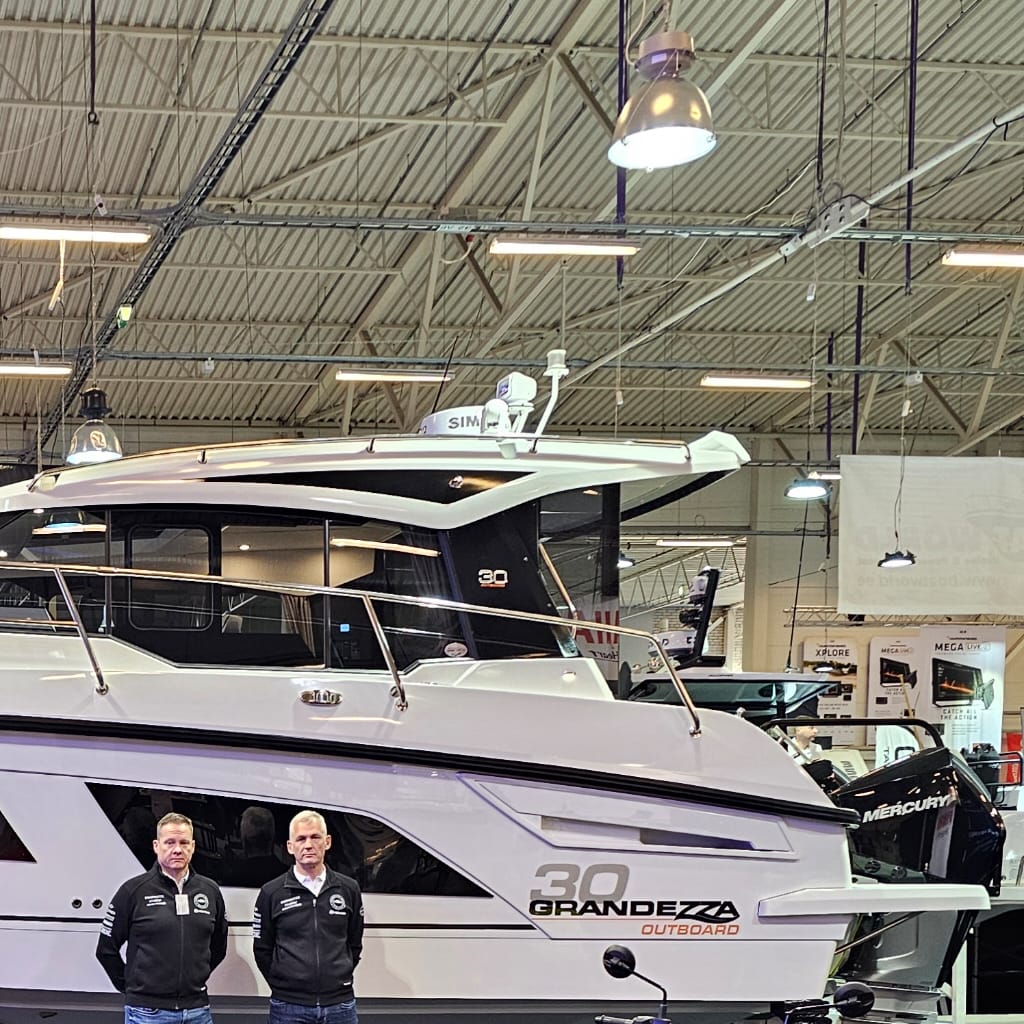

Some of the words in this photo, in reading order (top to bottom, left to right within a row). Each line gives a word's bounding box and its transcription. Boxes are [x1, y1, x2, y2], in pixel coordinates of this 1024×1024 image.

[477, 568, 508, 585] 30
[815, 648, 851, 657] XPLORE
[934, 642, 964, 652] MEGA
[862, 794, 952, 824] MERCURY
[529, 863, 630, 903] 30
[528, 900, 740, 923] GRANDEZZA
[640, 924, 740, 936] OUTBOARD
